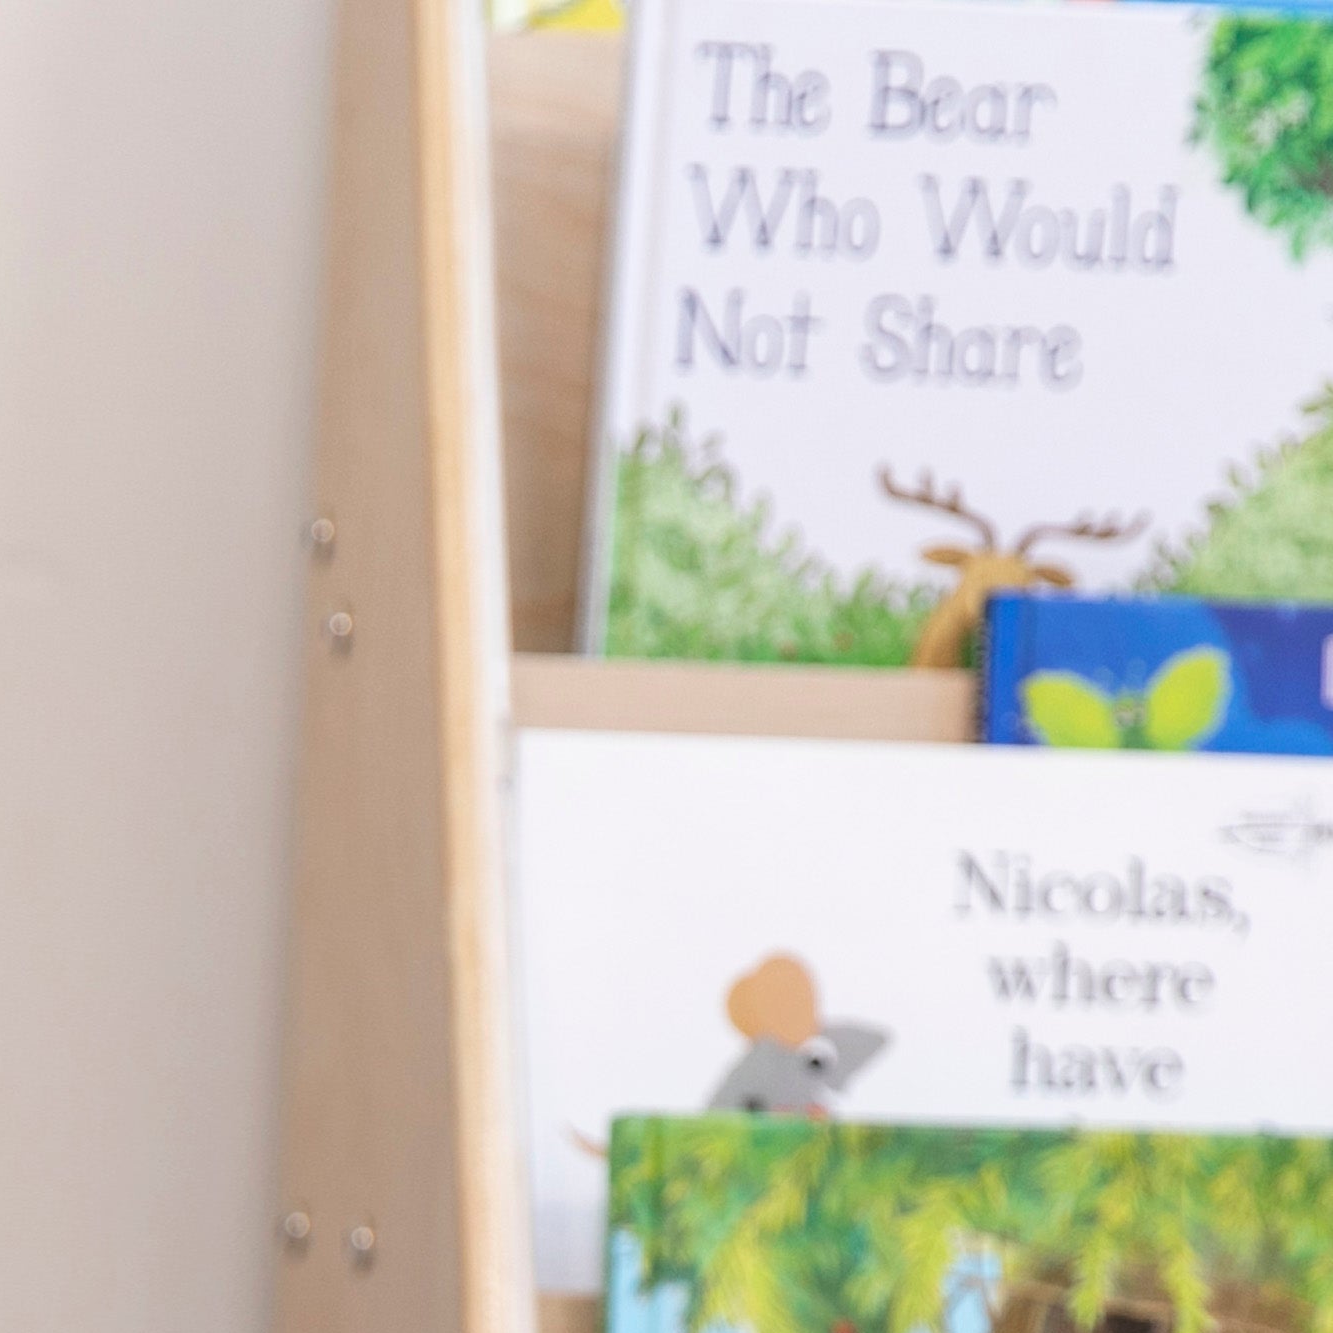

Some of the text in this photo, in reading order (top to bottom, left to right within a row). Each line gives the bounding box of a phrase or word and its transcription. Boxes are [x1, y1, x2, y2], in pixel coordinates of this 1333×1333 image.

[699, 40, 1057, 144] The Bear
[687, 163, 1177, 272] Who Would
[675, 287, 1083, 388] Not Share
[953, 850, 1250, 931] Nicolas,
[986, 940, 1215, 1006] where
[1009, 1029, 1185, 1097] have
